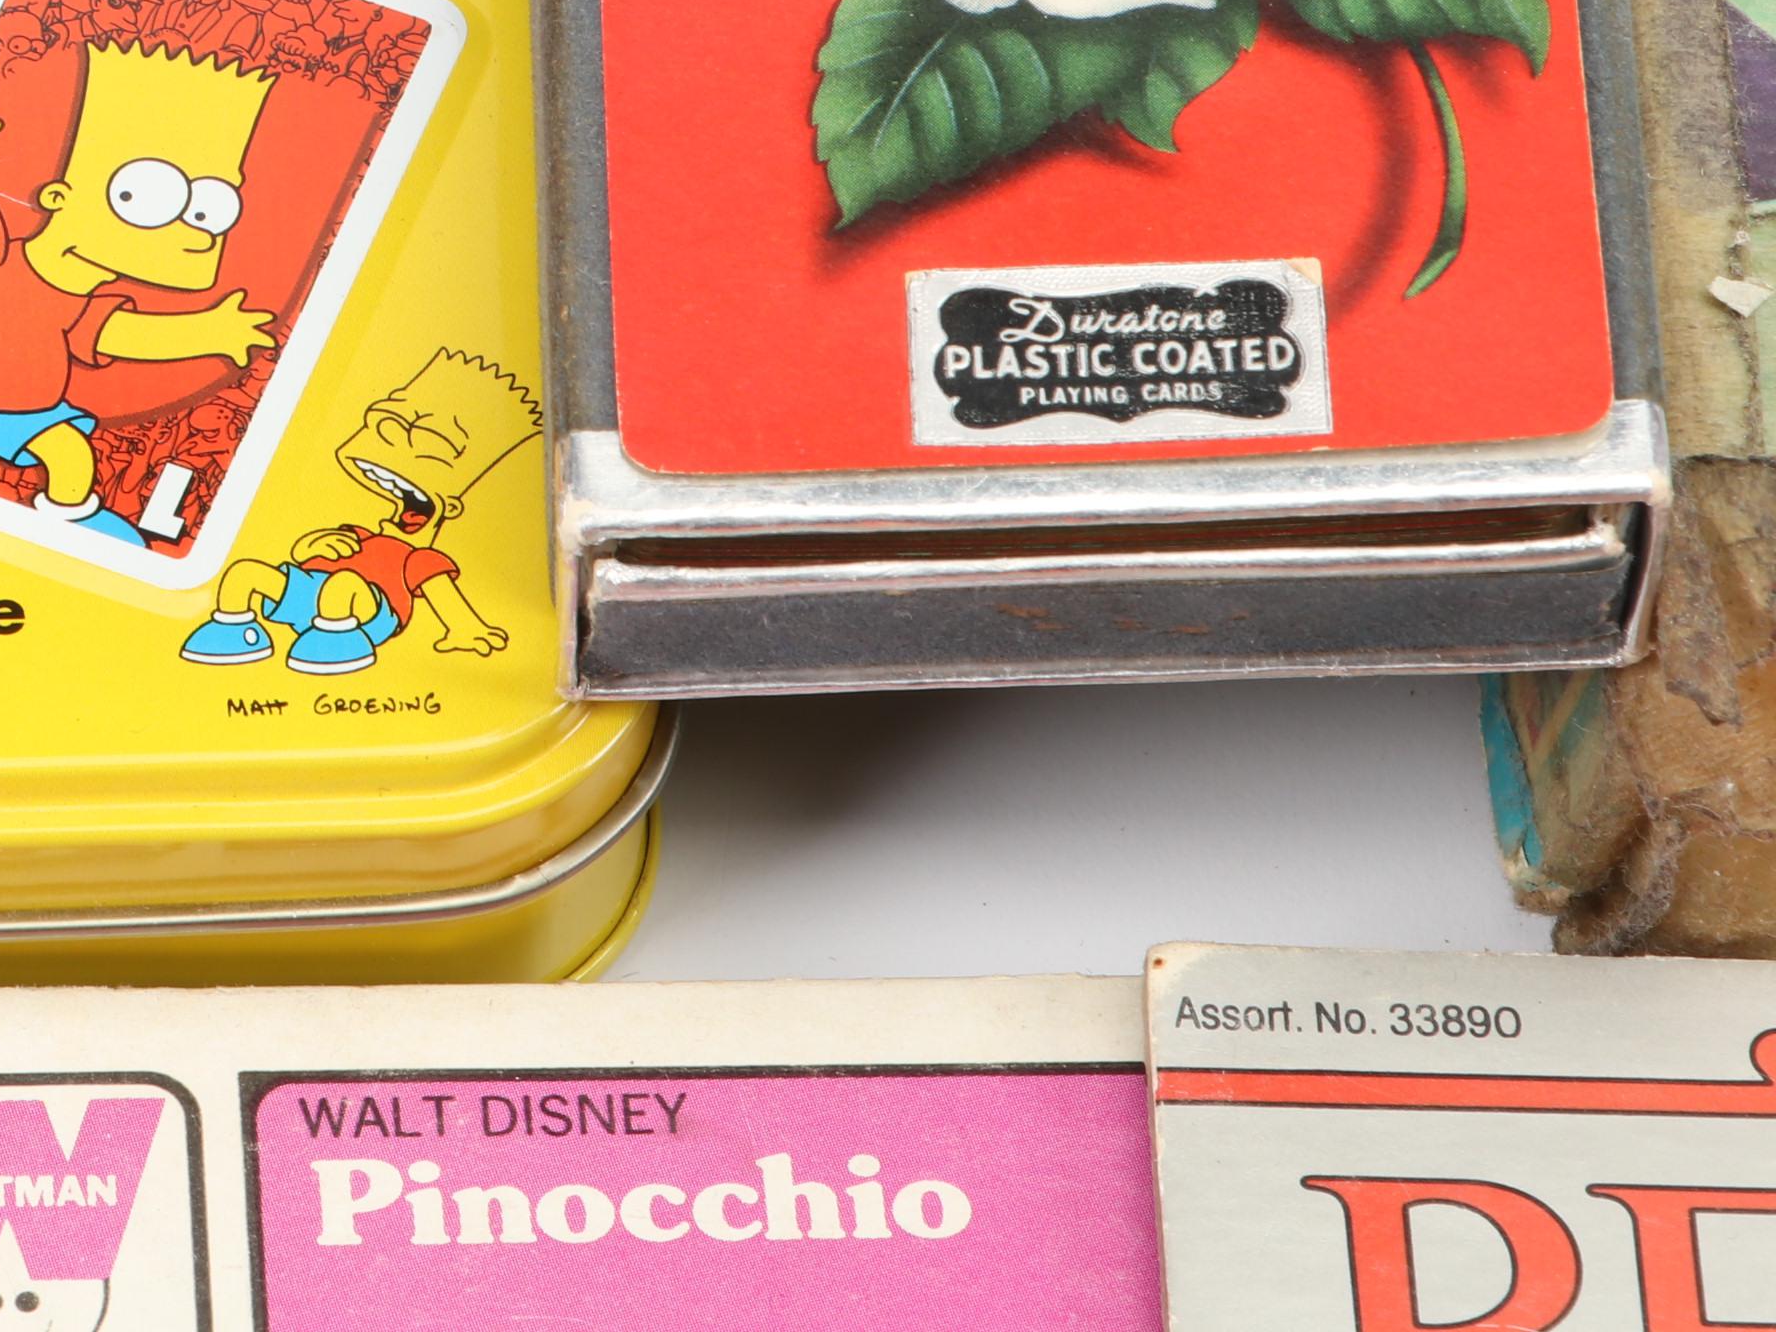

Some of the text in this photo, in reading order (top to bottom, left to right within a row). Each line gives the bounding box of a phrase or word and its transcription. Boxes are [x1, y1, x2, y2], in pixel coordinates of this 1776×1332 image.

[1000, 297, 1228, 343] Duratone
[942, 336, 1296, 379] PLASTIC COATED
[1021, 382, 1222, 405] PLAYING CARDS
[313, 691, 442, 715] GROENING
[1175, 995, 1524, 1038] Assort. No. 33890
[299, 1092, 688, 1140] WALT DISNEY
[310, 1152, 973, 1247] Pinocchio
